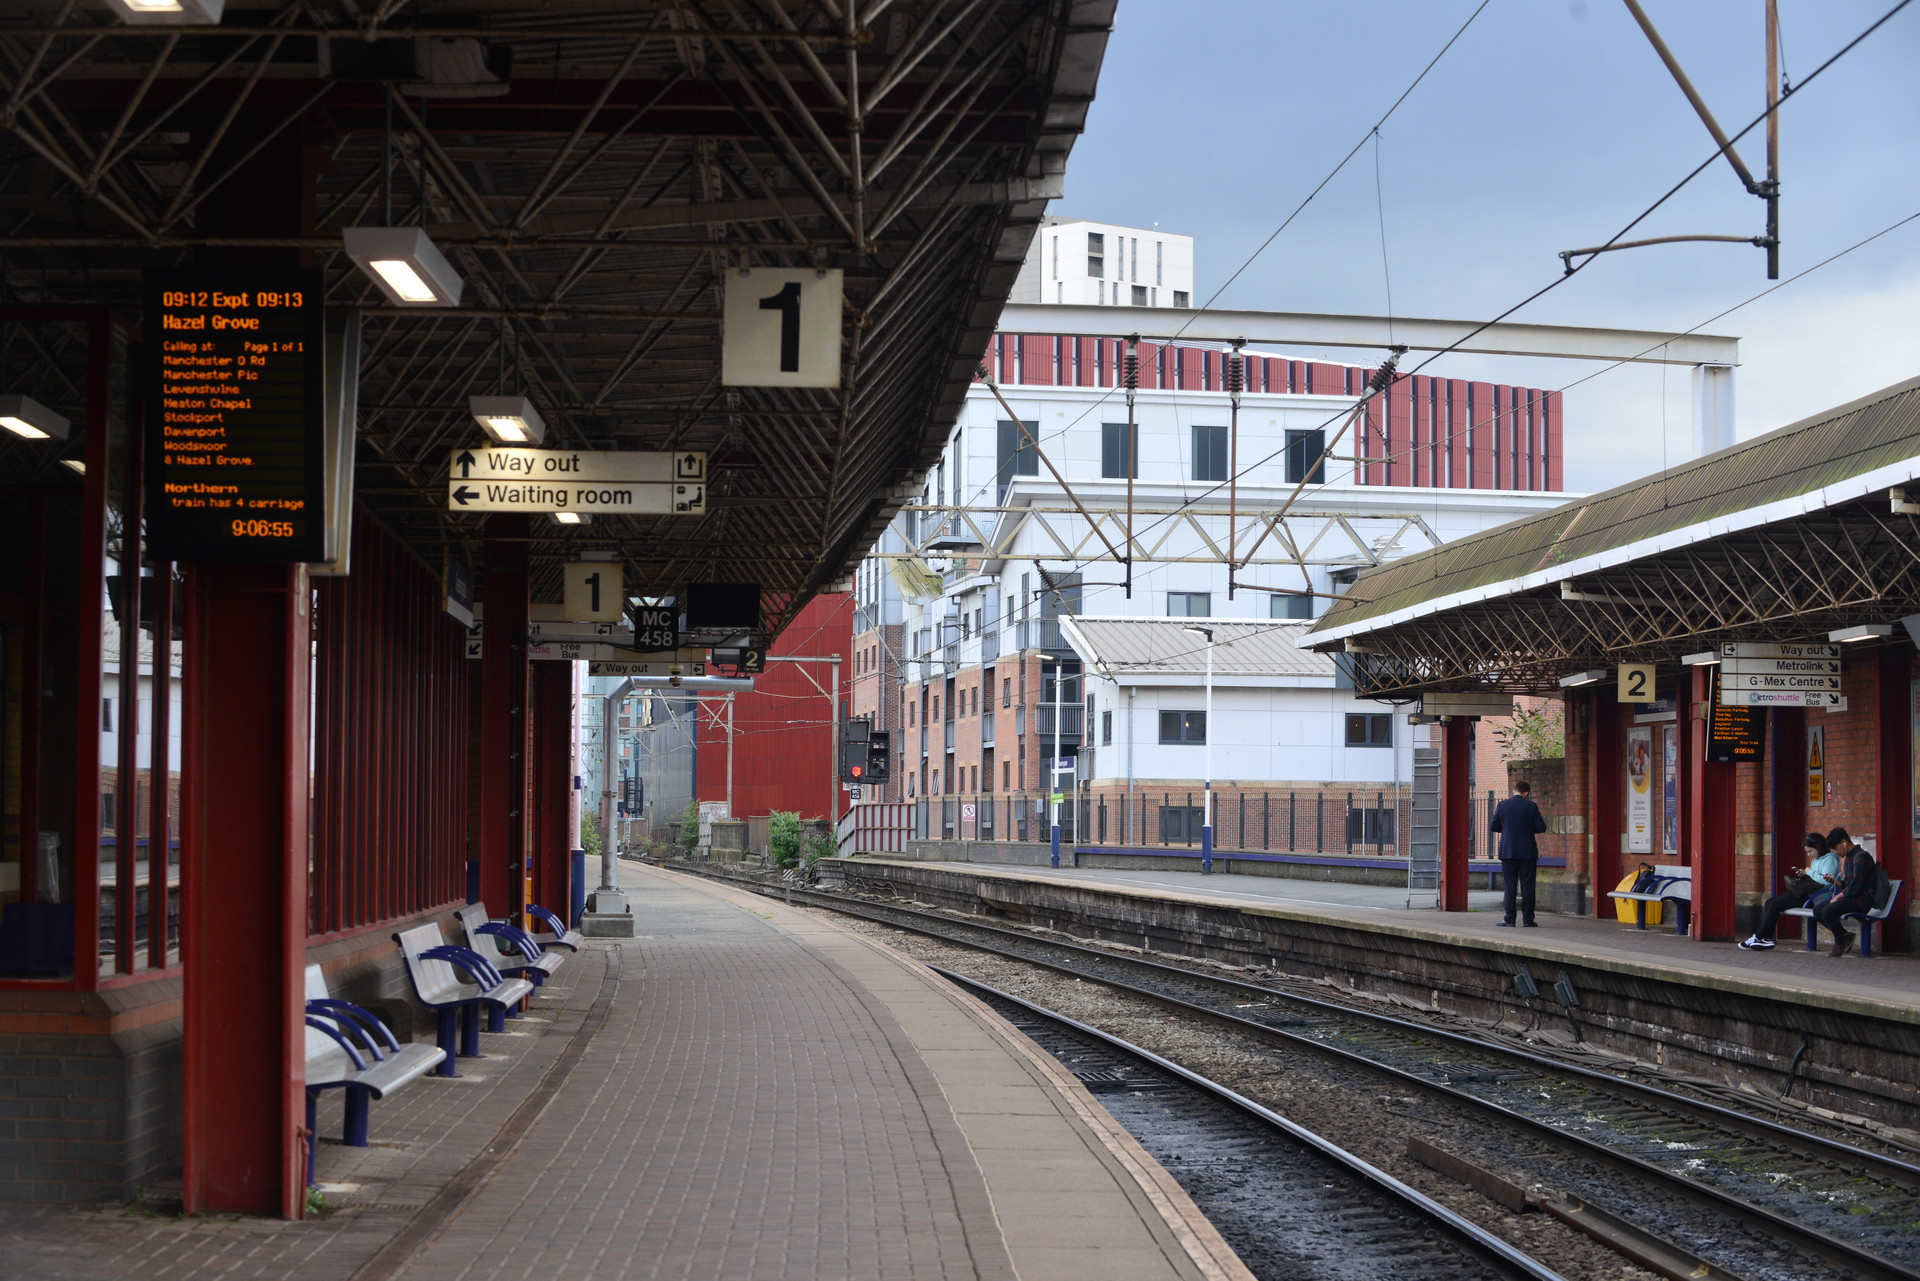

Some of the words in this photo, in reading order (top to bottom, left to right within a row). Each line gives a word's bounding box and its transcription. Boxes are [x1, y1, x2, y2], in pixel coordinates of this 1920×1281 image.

[163, 292, 208, 307] 09:12
[213, 292, 250, 309] Expt
[257, 292, 303, 307] 09:13
[163, 315, 205, 329] Hazel
[212, 315, 260, 330] Grove
[759, 282, 801, 372] 1
[164, 341, 197, 353] Calling
[201, 342, 216, 352] at:
[245, 342, 269, 353] Page
[273, 342, 278, 352] 1
[282, 342, 294, 352] of
[299, 342, 304, 352] 1
[164, 356, 232, 366] Manchester
[251, 356, 265, 366] Rd
[164, 370, 232, 380] Manchester
[238, 370, 258, 380] Pic
[164, 384, 240, 394] Levenshulme
[164, 398, 205, 409] Heaton
[210, 398, 251, 411] Chapel
[164, 412, 223, 424] Stockport
[164, 426, 226, 438] Davenport
[164, 441, 227, 451] Woodsmoor
[165, 455, 172, 464] &
[177, 455, 211, 465] Hazel
[217, 455, 256, 465] Grove.
[488, 452, 535, 475] Way
[544, 454, 580, 472] out
[165, 483, 238, 494] Northern
[487, 485, 568, 507] Waiting
[576, 489, 632, 505] room
[173, 498, 205, 507] train
[210, 498, 231, 507] has
[237, 498, 244, 507] 4
[249, 498, 304, 510] carriage
[232, 520, 293, 537] 9:06:55
[585, 573, 599, 612] 1
[643, 611, 671, 626] MC
[640, 631, 673, 646] 458
[562, 651, 579, 659] Bus
[1780, 645, 1803, 656] Way
[1807, 646, 1824, 655] out
[746, 652, 758, 667] 2
[1776, 661, 1824, 670] Metrolink
[605, 664, 628, 674] Way
[632, 664, 648, 673] out
[1627, 670, 1646, 696] 2
[1789, 677, 1824, 686] Centre
